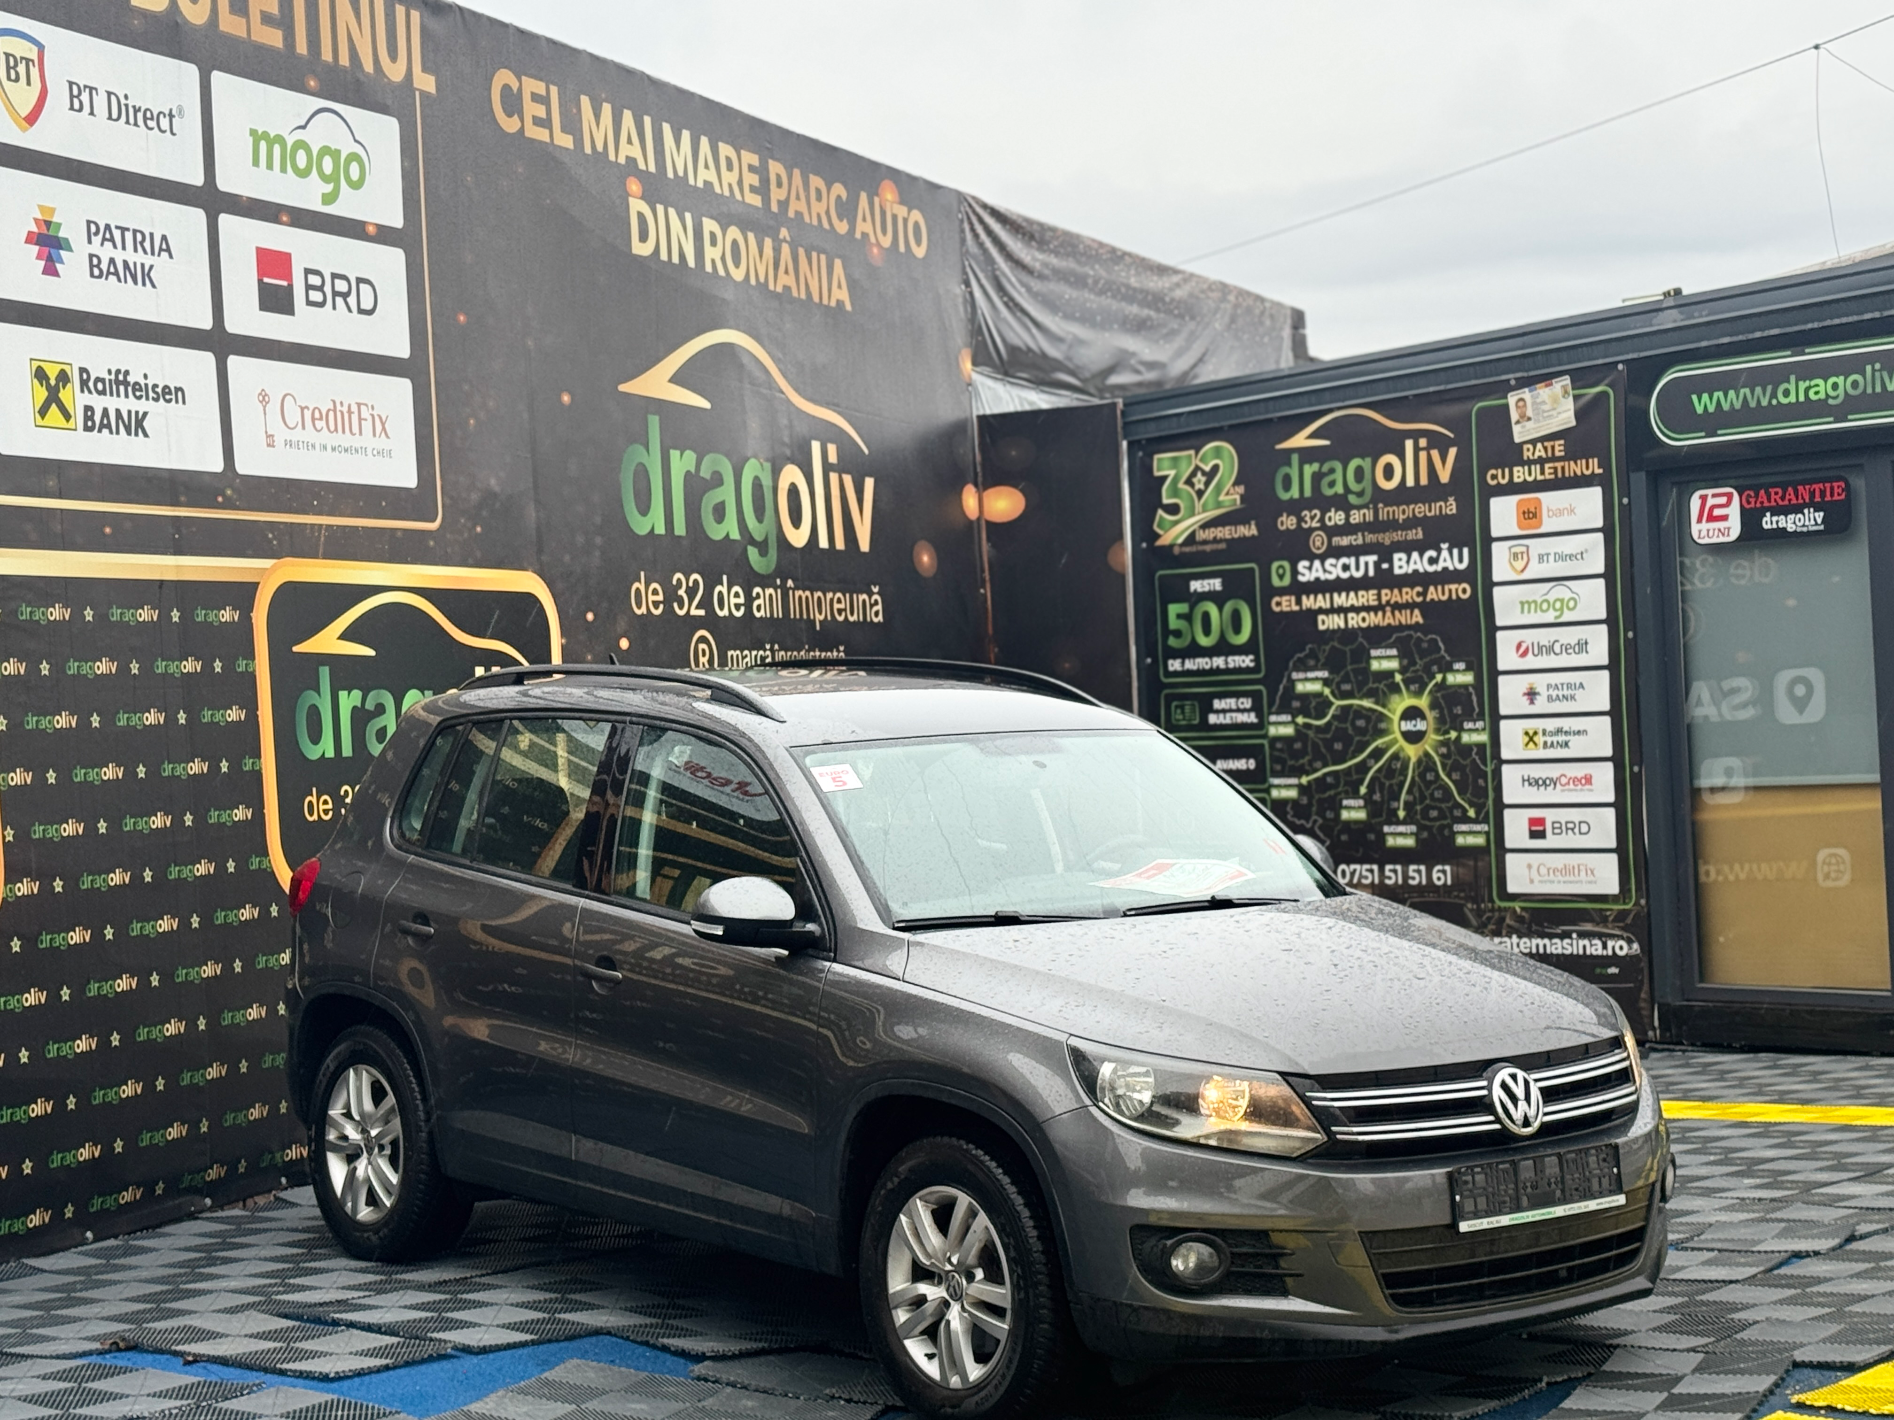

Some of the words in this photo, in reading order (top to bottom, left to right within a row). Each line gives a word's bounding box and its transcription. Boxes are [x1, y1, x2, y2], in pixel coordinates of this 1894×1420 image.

[3, 51, 36, 87] BT
[66, 79, 98, 118] BT
[249, 127, 367, 206] mogo
[491, 68, 575, 150] CEL
[580, 95, 656, 174] MAI
[661, 121, 763, 208] MARE
[767, 158, 849, 236] PARC
[853, 191, 929, 260] AUTO
[85, 218, 175, 260] PATRIA
[628, 196, 696, 269] DIN
[701, 216, 853, 313] ROMÂNIA
[87, 253, 158, 290] BANK
[303, 266, 379, 317] BRD
[78, 366, 187, 406] Raiffeisen
[82, 405, 151, 439] BANK
[279, 392, 391, 440] CreditFix
[283, 438, 317, 452] PRIETEN
[330, 444, 369, 457] MOMENTE
[1522, 440, 1565, 461] RATE
[1274, 438, 1458, 506] dragoliv
[1486, 468, 1510, 486] CU
[1512, 457, 1603, 484] BULETINUL
[620, 414, 875, 575] dragoliv
[1695, 491, 1734, 525] 12
[1741, 481, 1847, 509] GARANTIE
[1277, 513, 1297, 530] de
[1301, 509, 1321, 529] 32
[1324, 506, 1346, 526] de
[1350, 502, 1374, 523] ani
[1378, 497, 1457, 522] împreună
[1521, 507, 1538, 521] tbi
[1547, 504, 1577, 519] bank
[1762, 507, 1824, 532] dragoliv
[1332, 531, 1363, 547] marcă
[1364, 527, 1424, 546] înregistrată
[1697, 526, 1732, 540] LUNI
[1296, 554, 1378, 583] SASCUT
[1392, 542, 1470, 576] BACĂU
[1537, 552, 1551, 565] BT
[1189, 578, 1223, 593] PESTE
[1271, 596, 1299, 613] CEL
[1302, 593, 1331, 611] MAI
[1333, 589, 1379, 608] MARE
[1381, 585, 1424, 606] PARC
[1426, 581, 1472, 602] AUTO
[18, 603, 72, 625] dragoliv
[108, 605, 159, 625] dragoliv
[193, 606, 240, 626] dragoliv
[630, 571, 664, 615] de
[672, 572, 706, 616] 32
[712, 574, 746, 617] de
[752, 578, 782, 618] ani
[788, 582, 883, 630] împreună
[1519, 596, 1579, 621] mogo
[1166, 598, 1253, 649] 500
[1317, 614, 1346, 631] DIN
[1347, 607, 1424, 630] ROMÂNIA
[1530, 637, 1590, 659] UniCredit
[65, 657, 118, 679] dragoliv
[154, 656, 202, 677] dragoliv
[1167, 657, 1183, 672] DE
[1184, 656, 1212, 671] AUTO
[1212, 655, 1227, 670] PE
[1227, 653, 1256, 669] STOC
[1546, 681, 1586, 693] PATRIA
[1546, 692, 1577, 703] BANK
[1208, 711, 1258, 725] BULETINUL
[1213, 699, 1237, 711] RATE
[1238, 697, 1252, 710] CU
[24, 710, 78, 733] dragoliv
[115, 708, 166, 729] dragoliv
[200, 705, 246, 726] dragoliv
[1541, 726, 1588, 739] Raiffeisen
[1542, 739, 1571, 750] BANK
[71, 762, 124, 785] dragoliv
[160, 757, 209, 780] dragoliv
[1216, 758, 1247, 771] AVANS
[831, 776, 848, 788] 5
[1521, 773, 1593, 791] HappyCredit
[303, 786, 333, 822] de
[30, 818, 85, 842] dragoliv
[122, 811, 173, 833] dragoliv
[207, 804, 253, 825] dragoliv
[1551, 820, 1591, 836] BRD
[78, 867, 131, 891] dragoliv
[166, 859, 216, 881] dragoliv
[1337, 863, 1379, 885] 0751
[1384, 864, 1402, 885] 51
[1407, 864, 1427, 885] 51
[1431, 864, 1452, 886] 61
[1536, 862, 1596, 879] CreditFix
[37, 926, 92, 950] dragoliv
[128, 914, 179, 937] dragoliv
[213, 903, 260, 925] dragoliv
[85, 973, 138, 997] dragoliv
[174, 960, 223, 984] dragoliv
[45, 1033, 98, 1058] dragoliv
[135, 1018, 186, 1042] dragoliv
[220, 1003, 267, 1027] dragoliv
[91, 1079, 143, 1106] dragoliv
[179, 1061, 228, 1087] dragoliv
[48, 1142, 101, 1169] dragoliv
[138, 1121, 188, 1148] dragoliv
[222, 1101, 269, 1128] dragoliv
